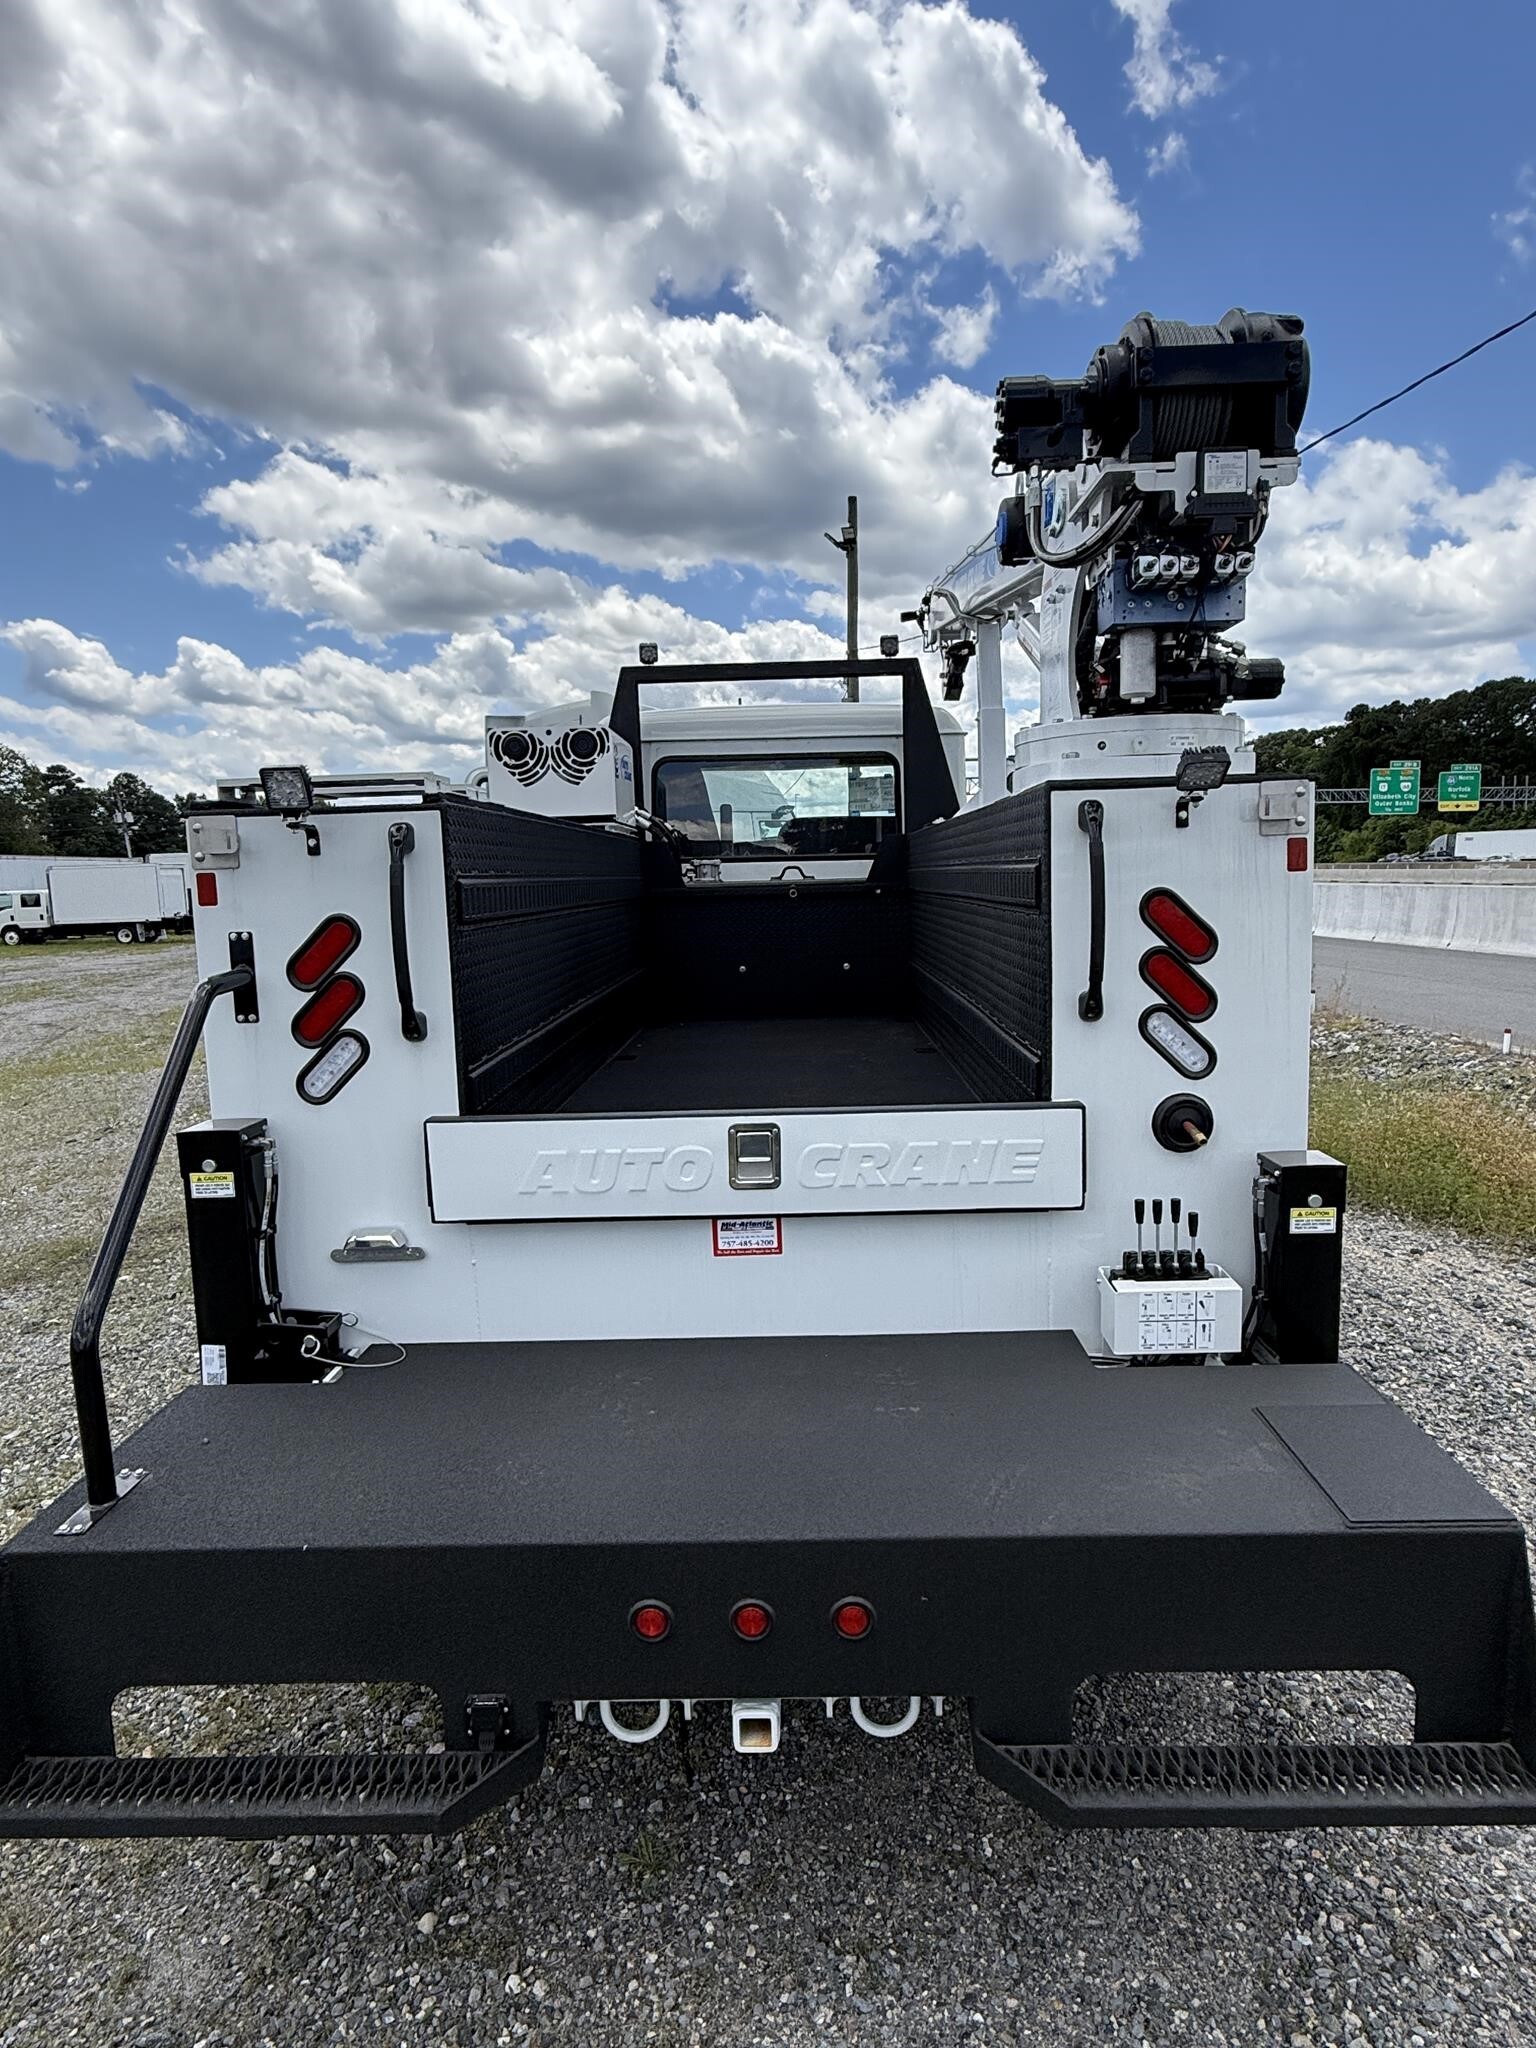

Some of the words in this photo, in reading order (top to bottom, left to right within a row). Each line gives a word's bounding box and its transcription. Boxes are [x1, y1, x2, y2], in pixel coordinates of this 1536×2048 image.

[519, 1145, 714, 1194] AUTO
[798, 1138, 1045, 1189] CRANE
[721, 1220, 774, 1231] Mid-Atlantic
